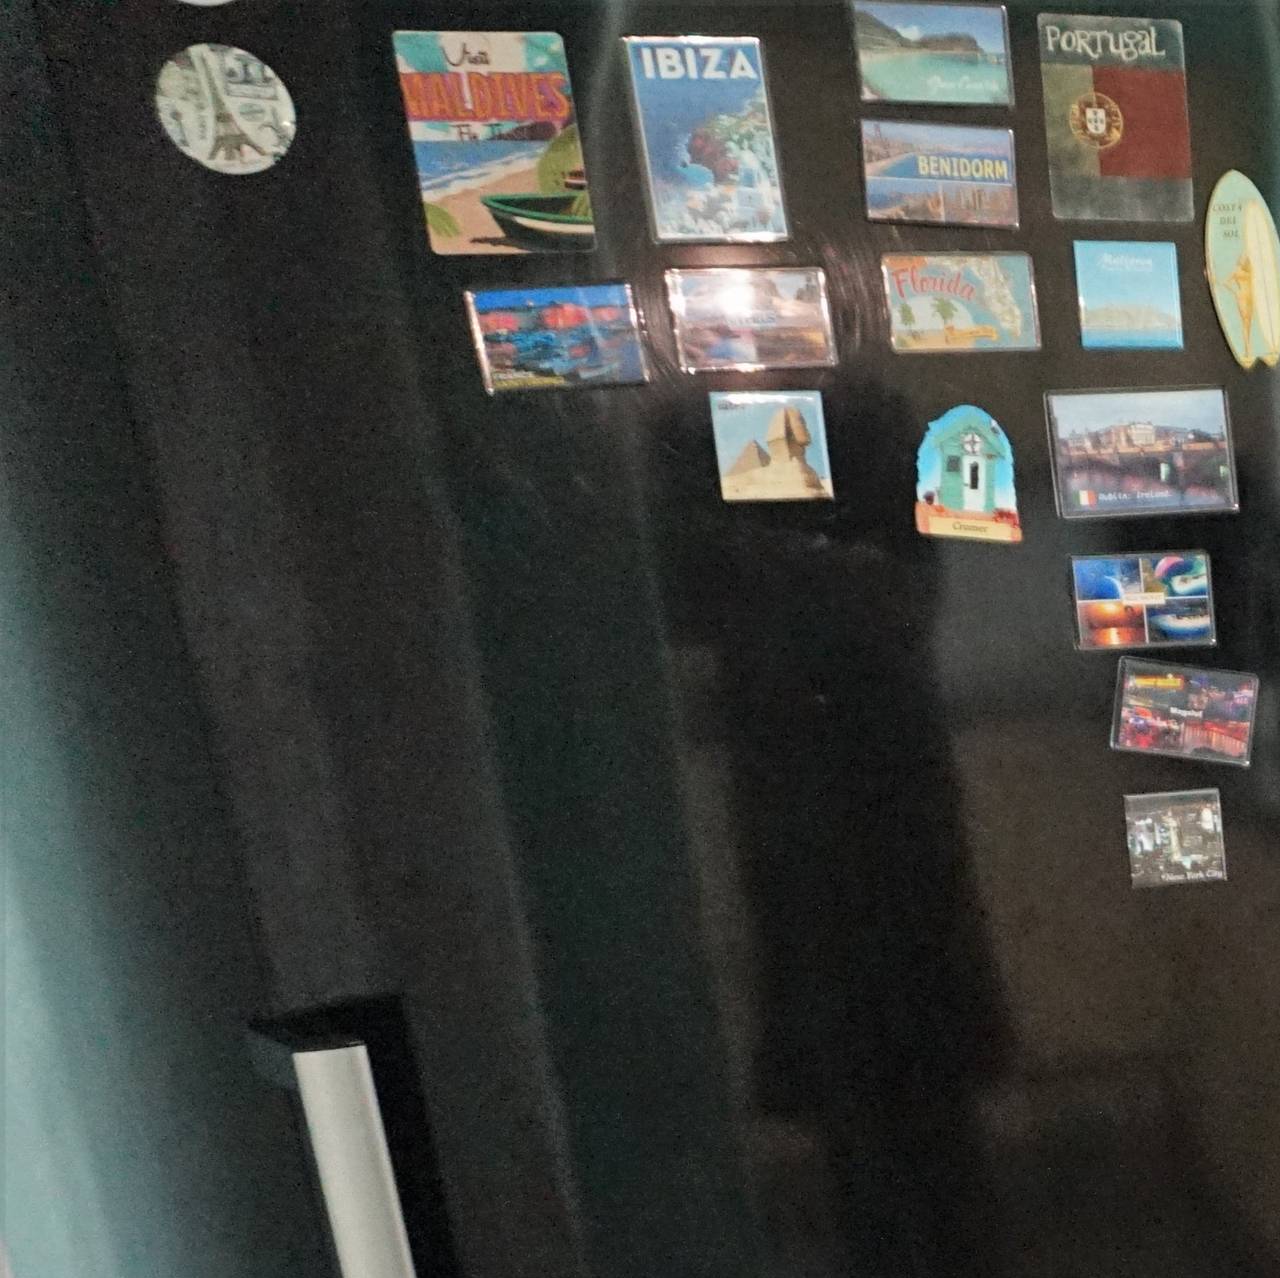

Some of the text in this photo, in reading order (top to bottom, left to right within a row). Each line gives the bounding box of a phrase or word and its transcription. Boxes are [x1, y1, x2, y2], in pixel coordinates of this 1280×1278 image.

[641, 47, 758, 79] IBIZA
[399, 71, 572, 121] MALDIVES
[917, 155, 1008, 179] BENIDORM
[892, 266, 976, 300] Florida
